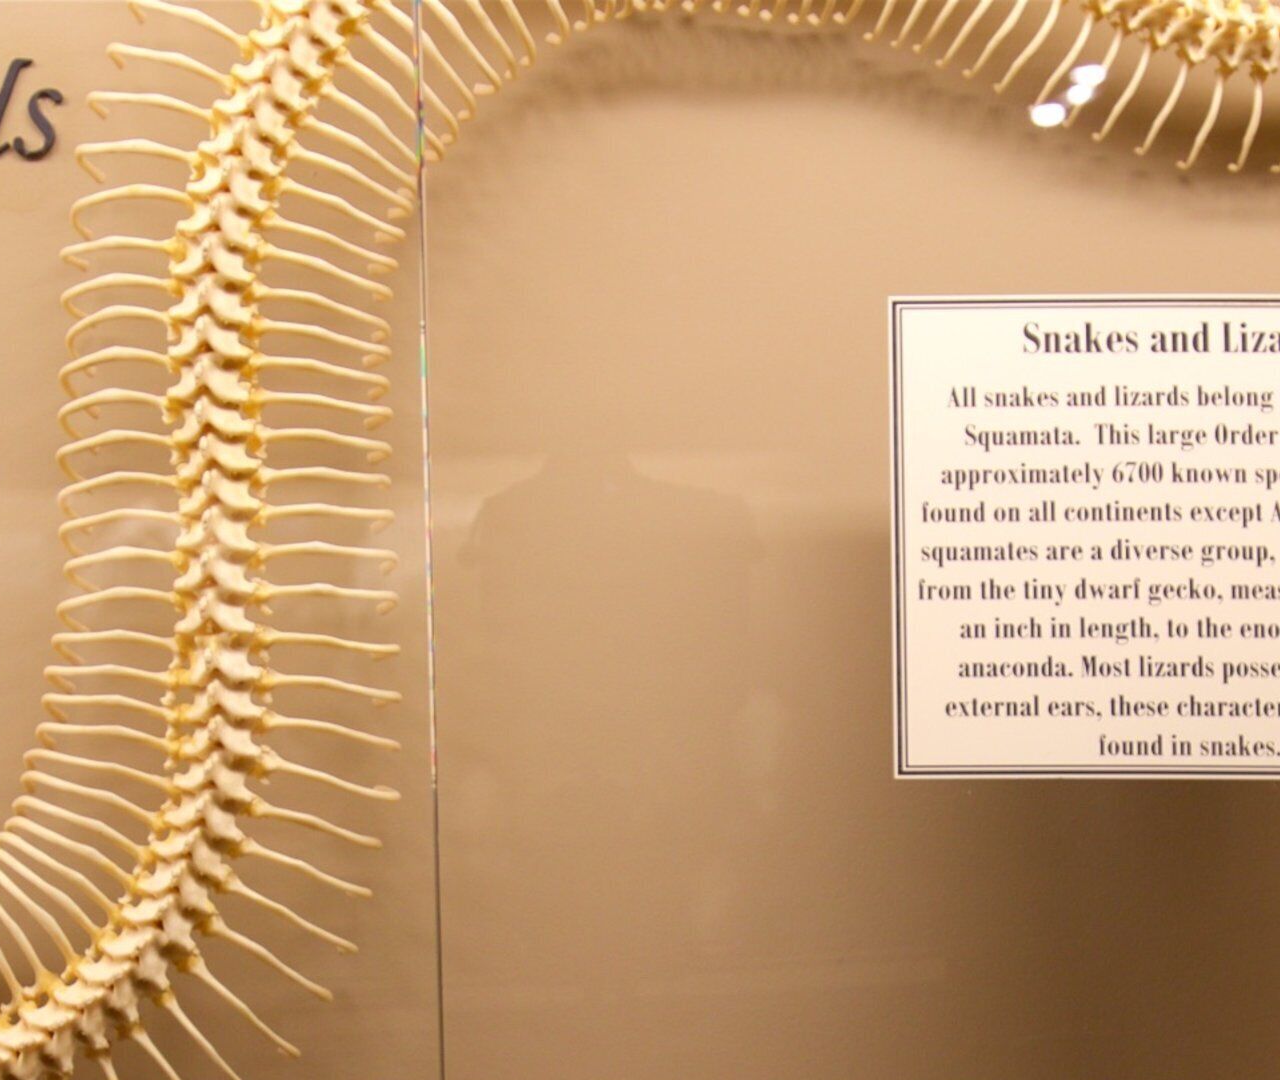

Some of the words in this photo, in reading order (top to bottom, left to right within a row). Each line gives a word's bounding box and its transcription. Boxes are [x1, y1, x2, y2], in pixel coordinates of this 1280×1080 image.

[1022, 321, 1139, 354] Snakes
[1150, 321, 1210, 354] and
[946, 386, 977, 408] All
[983, 385, 1060, 408] snakes
[1066, 385, 1107, 408] and
[1114, 384, 1190, 407] lizards
[1197, 384, 1274, 413] belong
[964, 425, 1081, 453] Squamata.
[1094, 423, 1141, 446] This
[1147, 423, 1207, 451] large
[1214, 423, 1279, 446] Order
[940, 461, 1104, 491] approximately
[1111, 461, 1164, 484] 6700
[1171, 461, 1248, 484] known
[921, 500, 986, 524] found
[993, 506, 1021, 523] on
[1028, 500, 1056, 523] all
[1063, 499, 1183, 523] continents
[1189, 503, 1263, 529] except
[920, 541, 1039, 569] squamates
[1045, 545, 1084, 561] are
[1090, 545, 1103, 561] a
[1110, 538, 1194, 561] diverse
[1201, 544, 1276, 568] group,
[918, 578, 972, 601] from
[980, 577, 1016, 601] the
[1023, 577, 1066, 607] tiny
[1074, 577, 1141, 600] dwarf
[1148, 577, 1224, 606] gecko,
[959, 623, 987, 640] an
[994, 616, 1043, 639] inch
[1050, 616, 1072, 639] in
[1079, 615, 1160, 645] length,
[1167, 618, 1190, 639] to
[1196, 616, 1233, 639] the
[958, 655, 1074, 678] anaconda.
[1081, 655, 1131, 678] Most
[1138, 654, 1215, 678] lizards
[944, 694, 1040, 718] external
[1047, 701, 1103, 718] ears,
[1109, 694, 1170, 717] these
[1098, 733, 1163, 757] found
[1171, 733, 1192, 757] in
